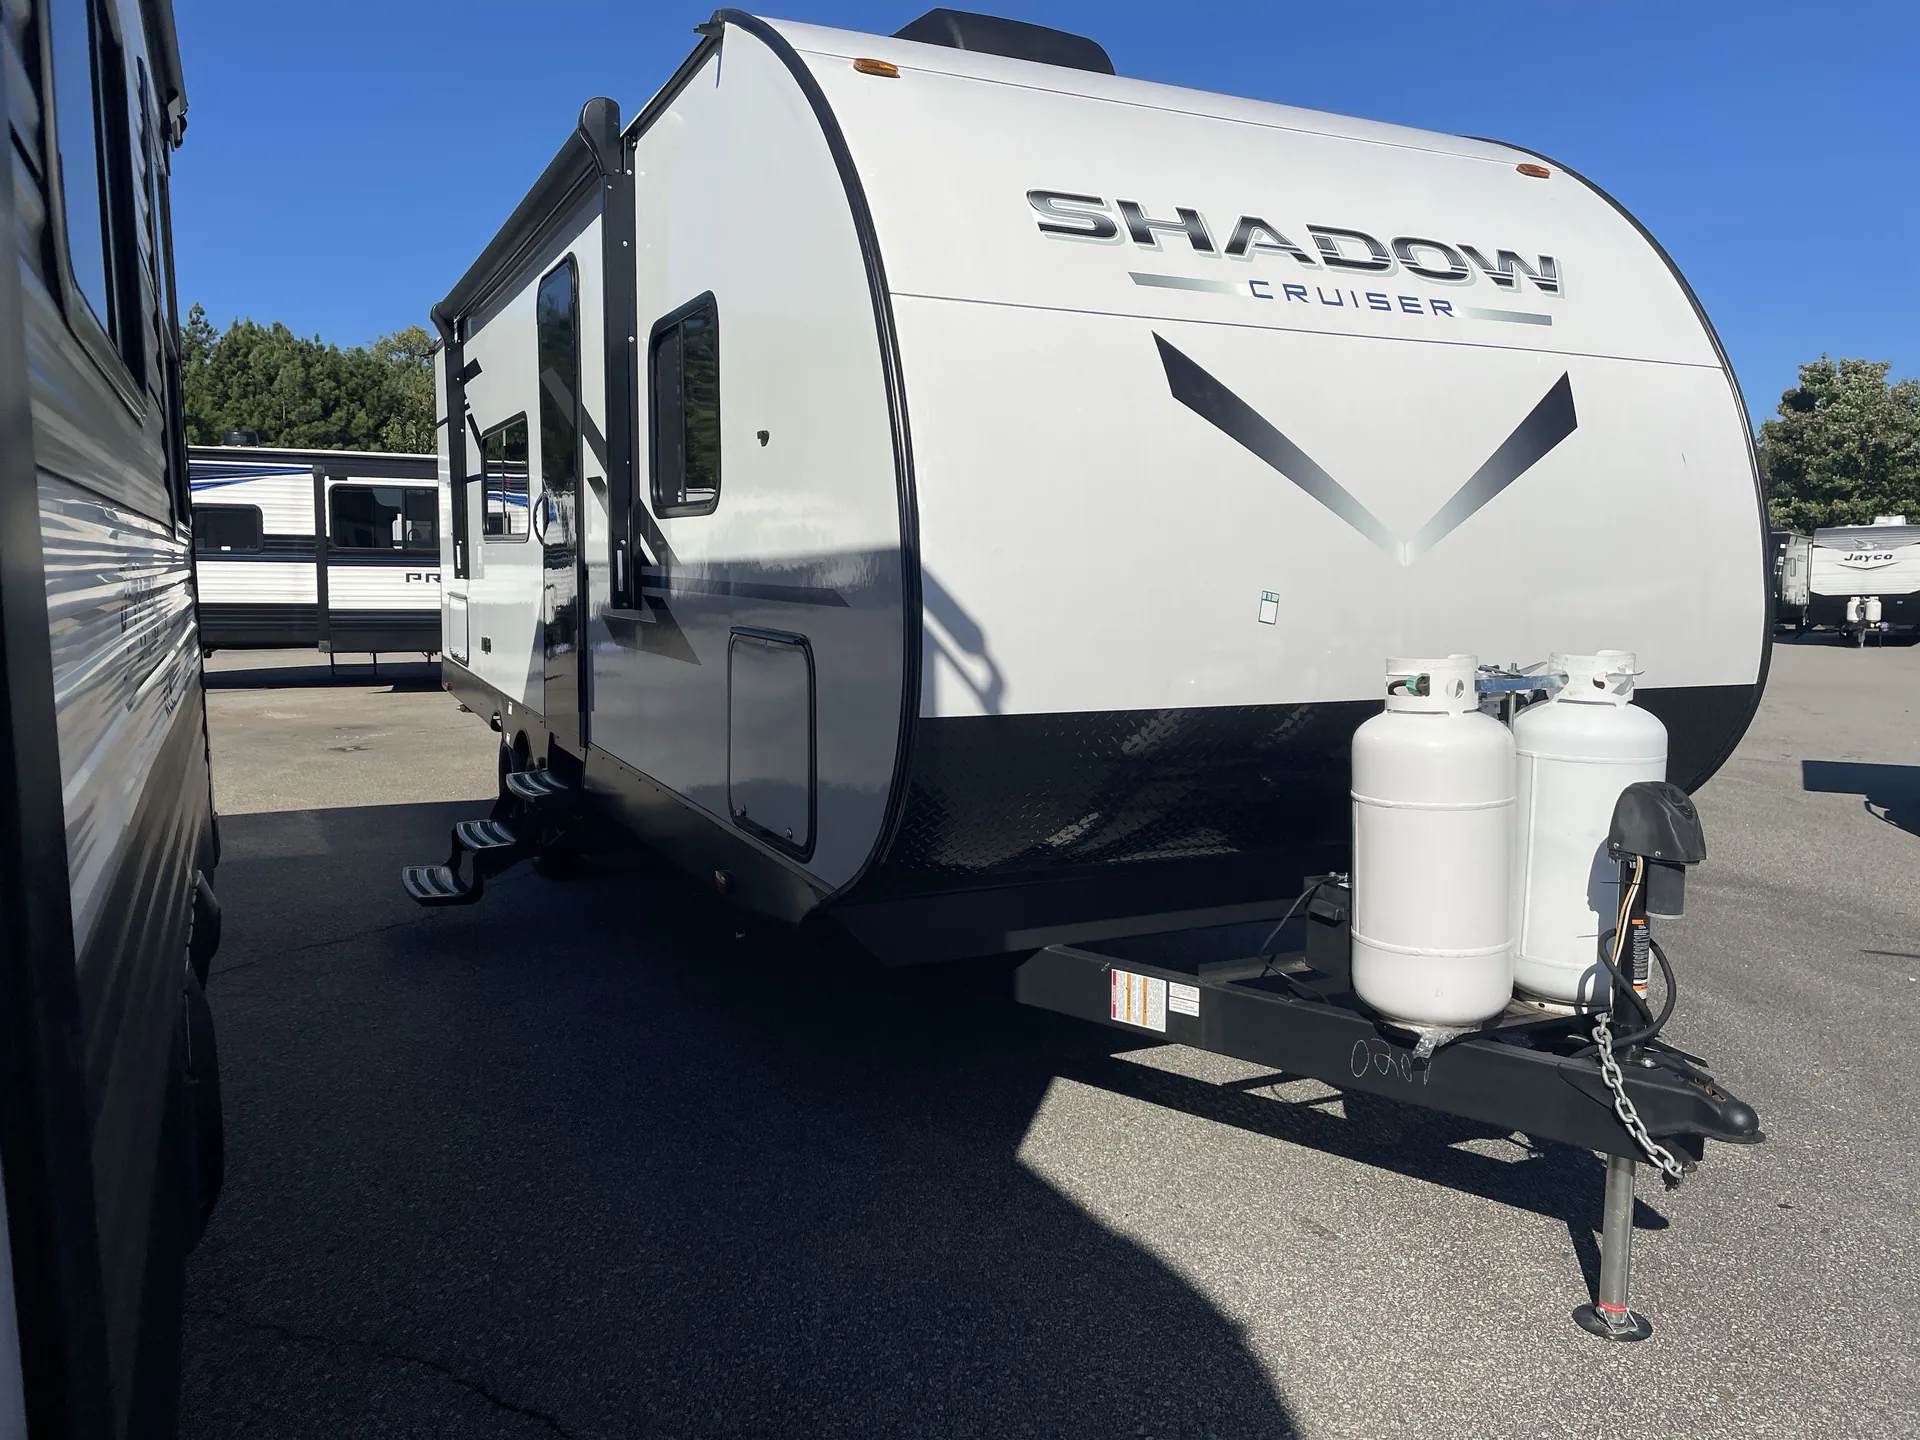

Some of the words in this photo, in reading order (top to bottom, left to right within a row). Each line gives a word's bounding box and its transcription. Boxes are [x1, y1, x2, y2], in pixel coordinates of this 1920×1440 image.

[1025, 187, 1564, 297] SHADOW
[1247, 279, 1455, 318] CRUISER
[1843, 553, 1893, 562] Jayco
